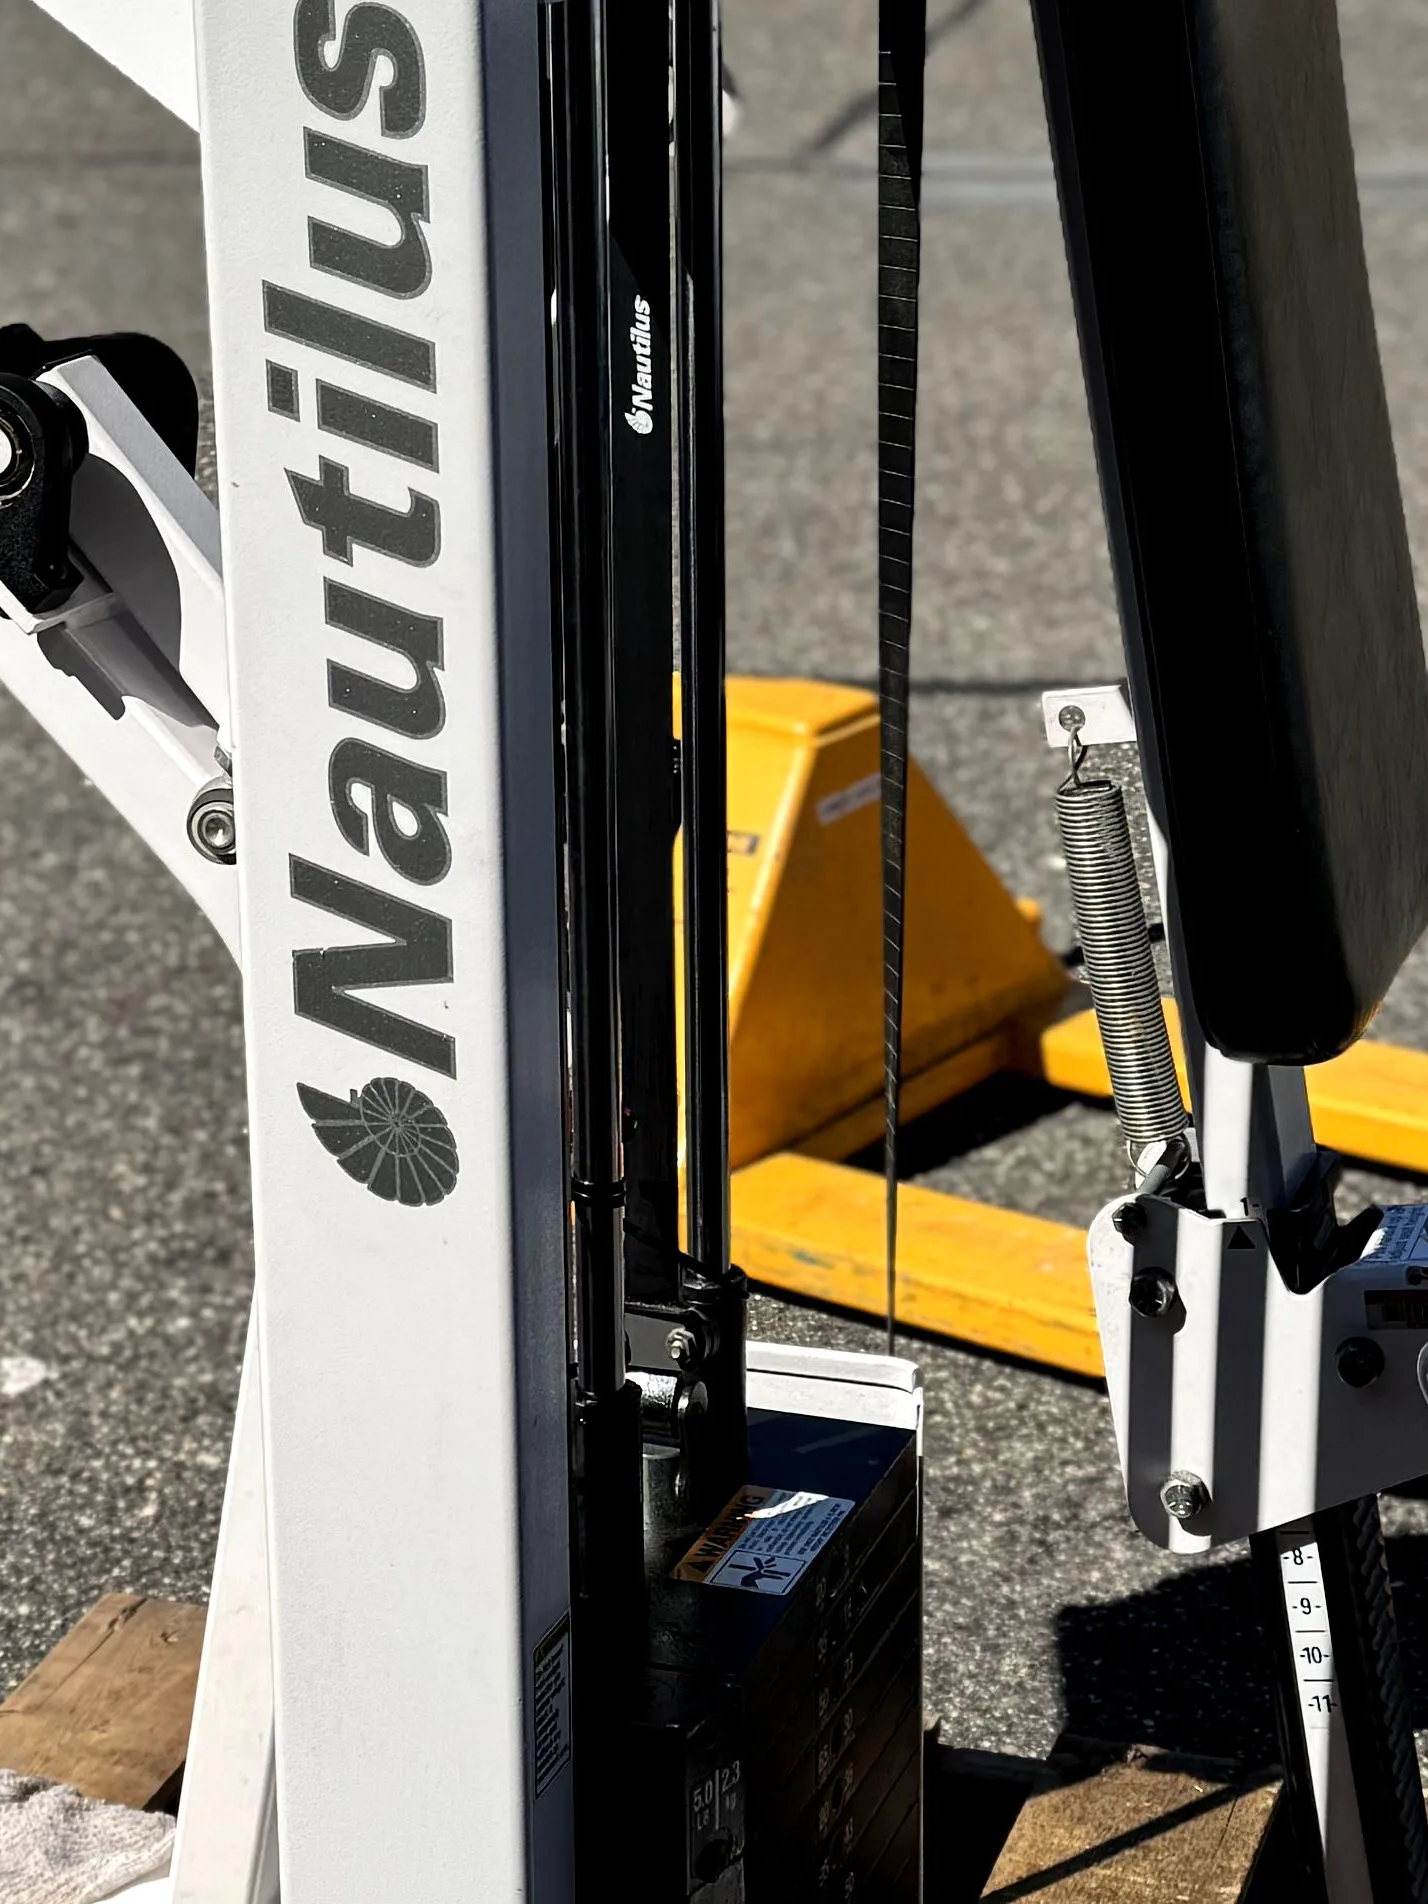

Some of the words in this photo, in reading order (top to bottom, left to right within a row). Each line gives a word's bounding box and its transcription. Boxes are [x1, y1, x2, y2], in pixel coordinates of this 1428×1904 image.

[629, 294, 653, 411] Nautilus
[693, 1779, 713, 1814] 5.0
[721, 1760, 741, 1794] 2.3
